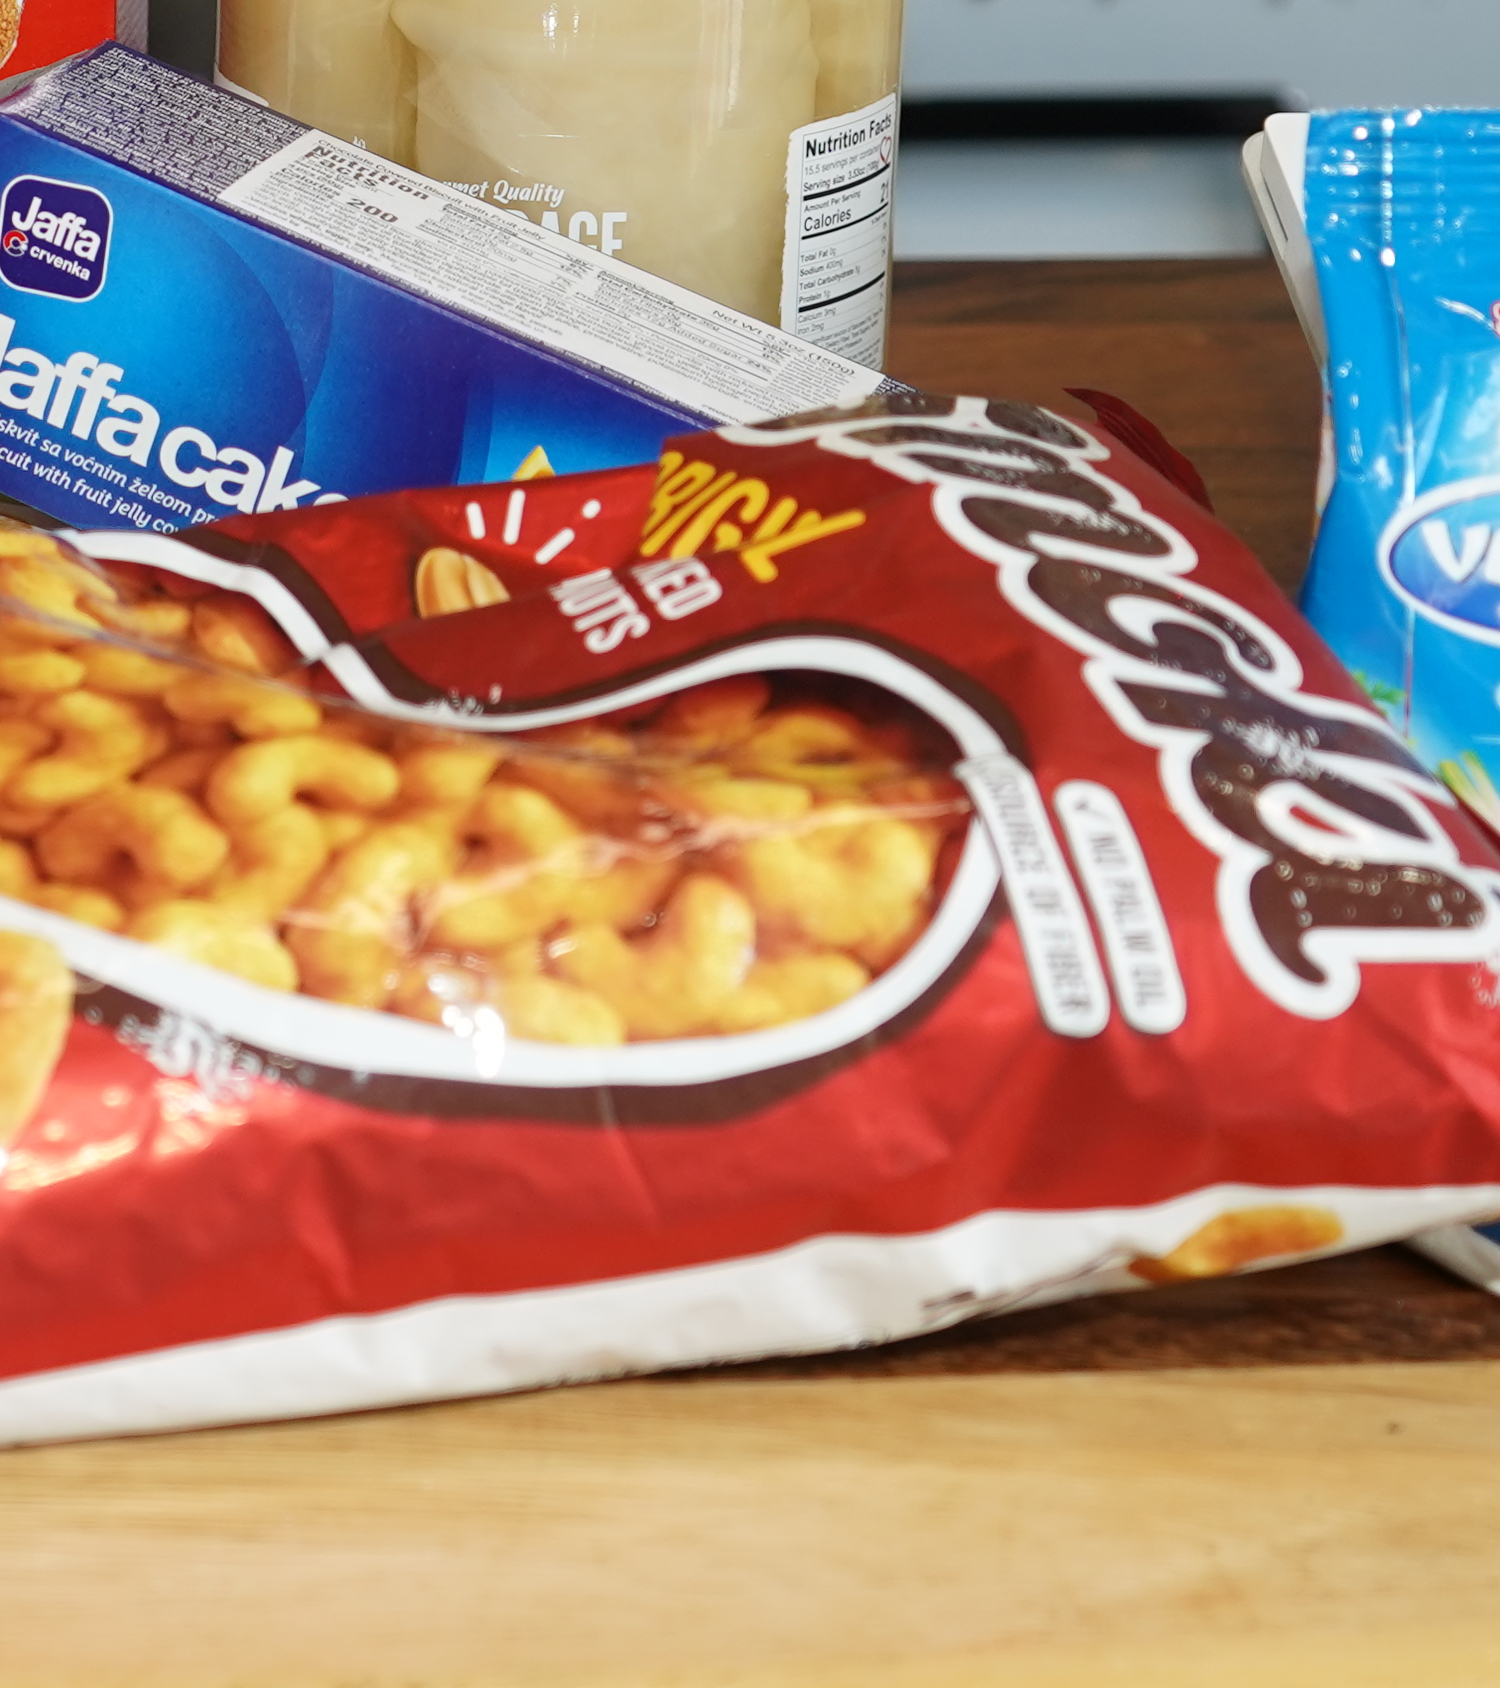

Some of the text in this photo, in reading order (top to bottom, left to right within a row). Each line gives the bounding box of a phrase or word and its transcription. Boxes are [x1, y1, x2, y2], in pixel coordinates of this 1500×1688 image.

[806, 113, 892, 158] Nutrition Facts
[302, 146, 431, 200] Nutrition Facts
[318, 140, 375, 166] Chocolate
[375, 164, 423, 187] Covered
[822, 158, 848, 172] servings
[493, 179, 565, 208] Quality
[804, 175, 845, 192] Serving size
[346, 197, 400, 224] 200
[804, 191, 860, 213] Amount Per Serving
[11, 196, 101, 262] Jaffa
[804, 208, 851, 232] Calories
[30, 244, 91, 280] crvenka
[800, 252, 817, 262] Total
[818, 249, 828, 258] Fat
[800, 265, 824, 277] Sodium
[800, 268, 854, 290] Total Carbohydrate
[799, 293, 822, 304] Protein
[798, 313, 822, 323] Calcium
[40, 436, 63, 459] sa
[159, 426, 350, 515] cak
[33, 458, 71, 490] with
[71, 474, 114, 509] fruit
[108, 491, 152, 530] jelly
